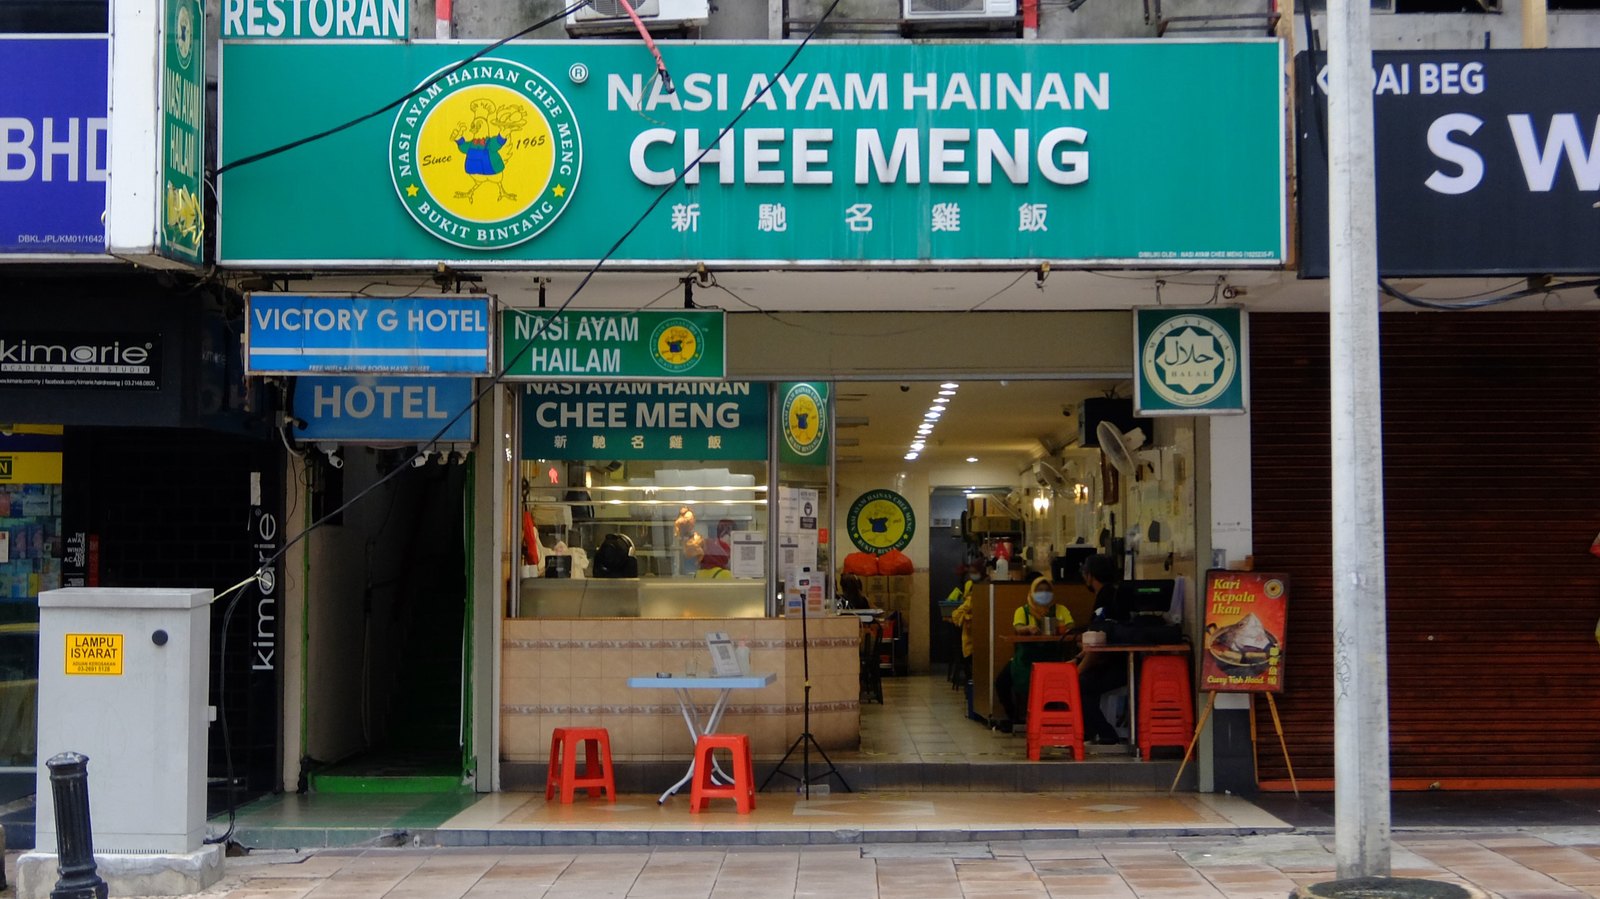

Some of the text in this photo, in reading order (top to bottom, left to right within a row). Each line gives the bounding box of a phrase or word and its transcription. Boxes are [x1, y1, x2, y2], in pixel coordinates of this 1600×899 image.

[224, 0, 405, 37] RESTORAN
[1419, 61, 1485, 95] BEG
[167, 67, 182, 121] NASI
[608, 72, 1110, 112] NASI AYAM HAINAN
[399, 66, 574, 177] NASI AYAM HAINAN CHEE MENG
[516, 135, 546, 150] 1965
[422, 154, 453, 167] Since
[629, 127, 1089, 186] CHEE MENG
[418, 201, 554, 240] BUKIT BINTANG
[255, 308, 486, 333] VICTORY G HOTEL
[514, 316, 639, 342] NASI AYAM
[0, 339, 149, 365] kimarie
[531, 347, 621, 373] HAILAM
[1171, 370, 1209, 378] HALAL
[313, 385, 447, 419] HOTEL
[536, 402, 740, 429] CHEE MENG
[252, 513, 276, 671] kimarie
[1213, 579, 1240, 590] Kari
[1213, 591, 1255, 603] Kepala
[1212, 603, 1241, 615] Ikan
[71, 648, 118, 659] ISYARAT
[75, 636, 114, 648] LAMPU
